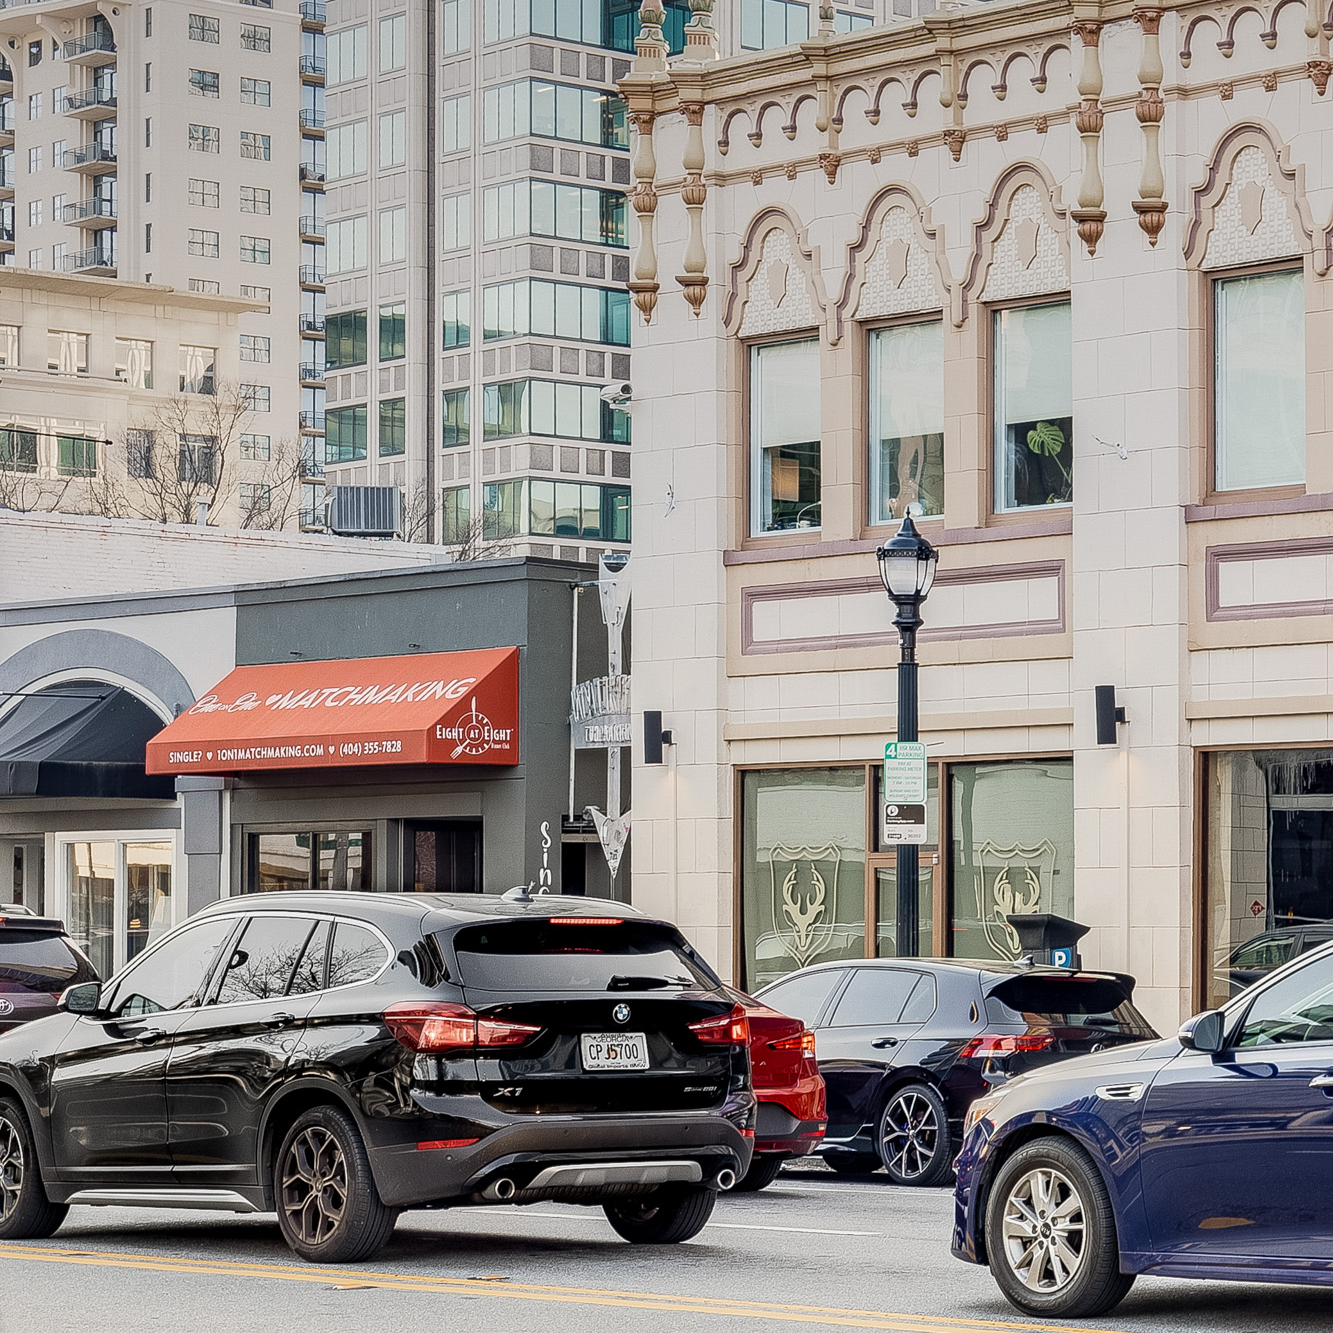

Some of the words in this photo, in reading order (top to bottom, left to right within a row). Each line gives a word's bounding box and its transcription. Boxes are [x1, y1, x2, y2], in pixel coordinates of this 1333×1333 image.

[270, 677, 477, 711] MATCHMAKING
[435, 724, 463, 739] EIGHT
[469, 729, 479, 738] AT
[169, 750, 203, 763] SINGLE?
[339, 742, 363, 757] (404)
[363, 740, 402, 755] 355-7828
[886, 743, 897, 758] 4
[1054, 951, 1066, 967] P
[493, 1087, 523, 1097] X1
